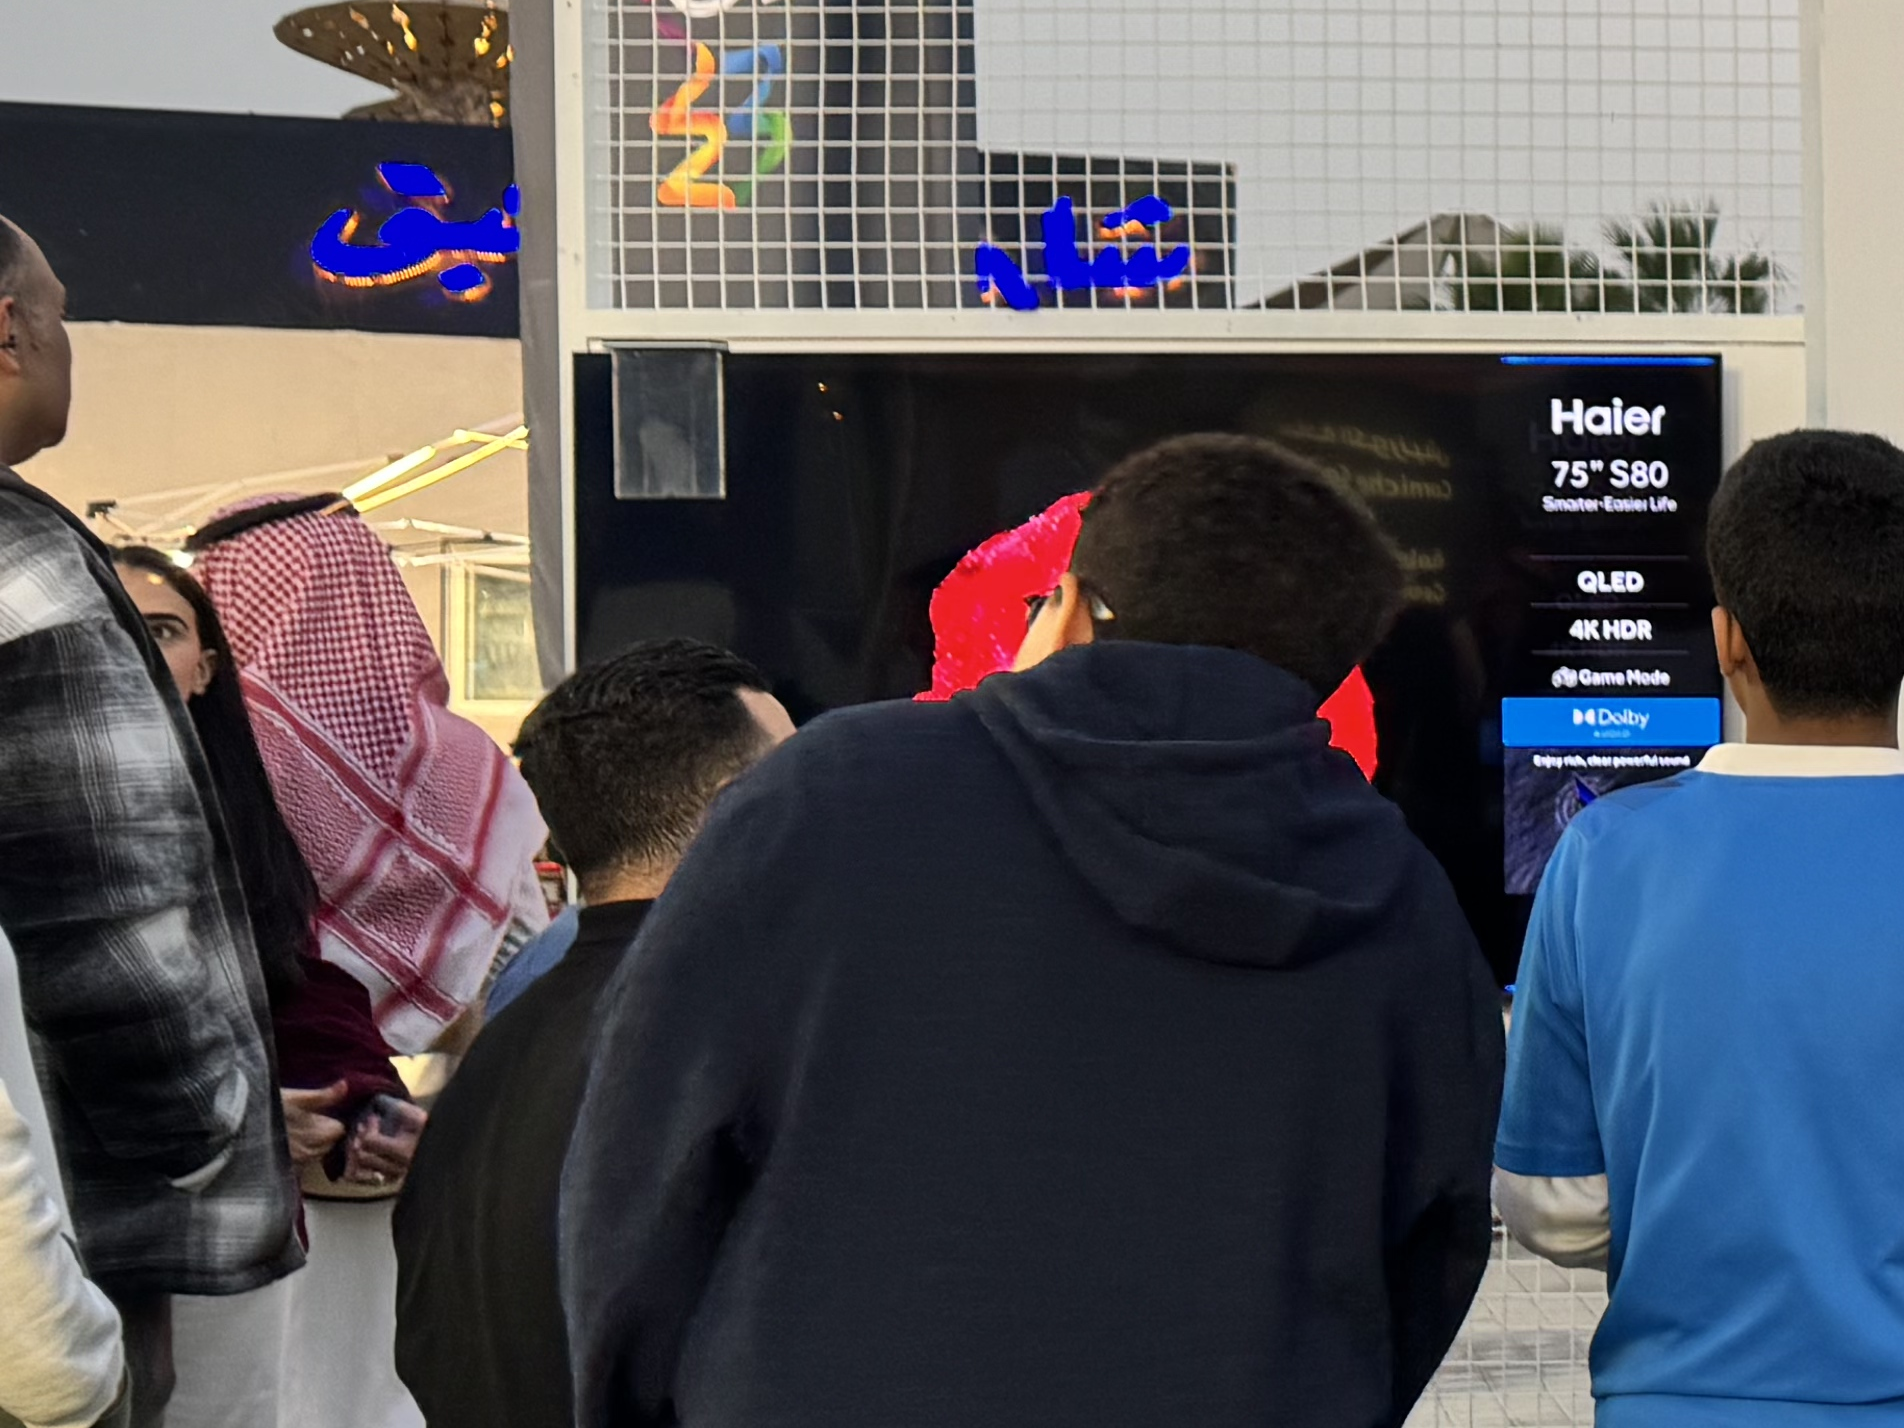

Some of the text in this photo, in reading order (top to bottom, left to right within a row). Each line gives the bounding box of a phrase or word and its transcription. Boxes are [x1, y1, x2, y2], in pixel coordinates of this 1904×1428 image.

[1551, 397, 1666, 435] Haier
[1610, 460, 1669, 488] S80
[1649, 496, 1677, 512] Life
[1577, 570, 1645, 594] QLED
[1569, 619, 1652, 640] 4K HDR
[1578, 669, 1671, 686] Game Mode
[1599, 708, 1650, 729] Dolby
